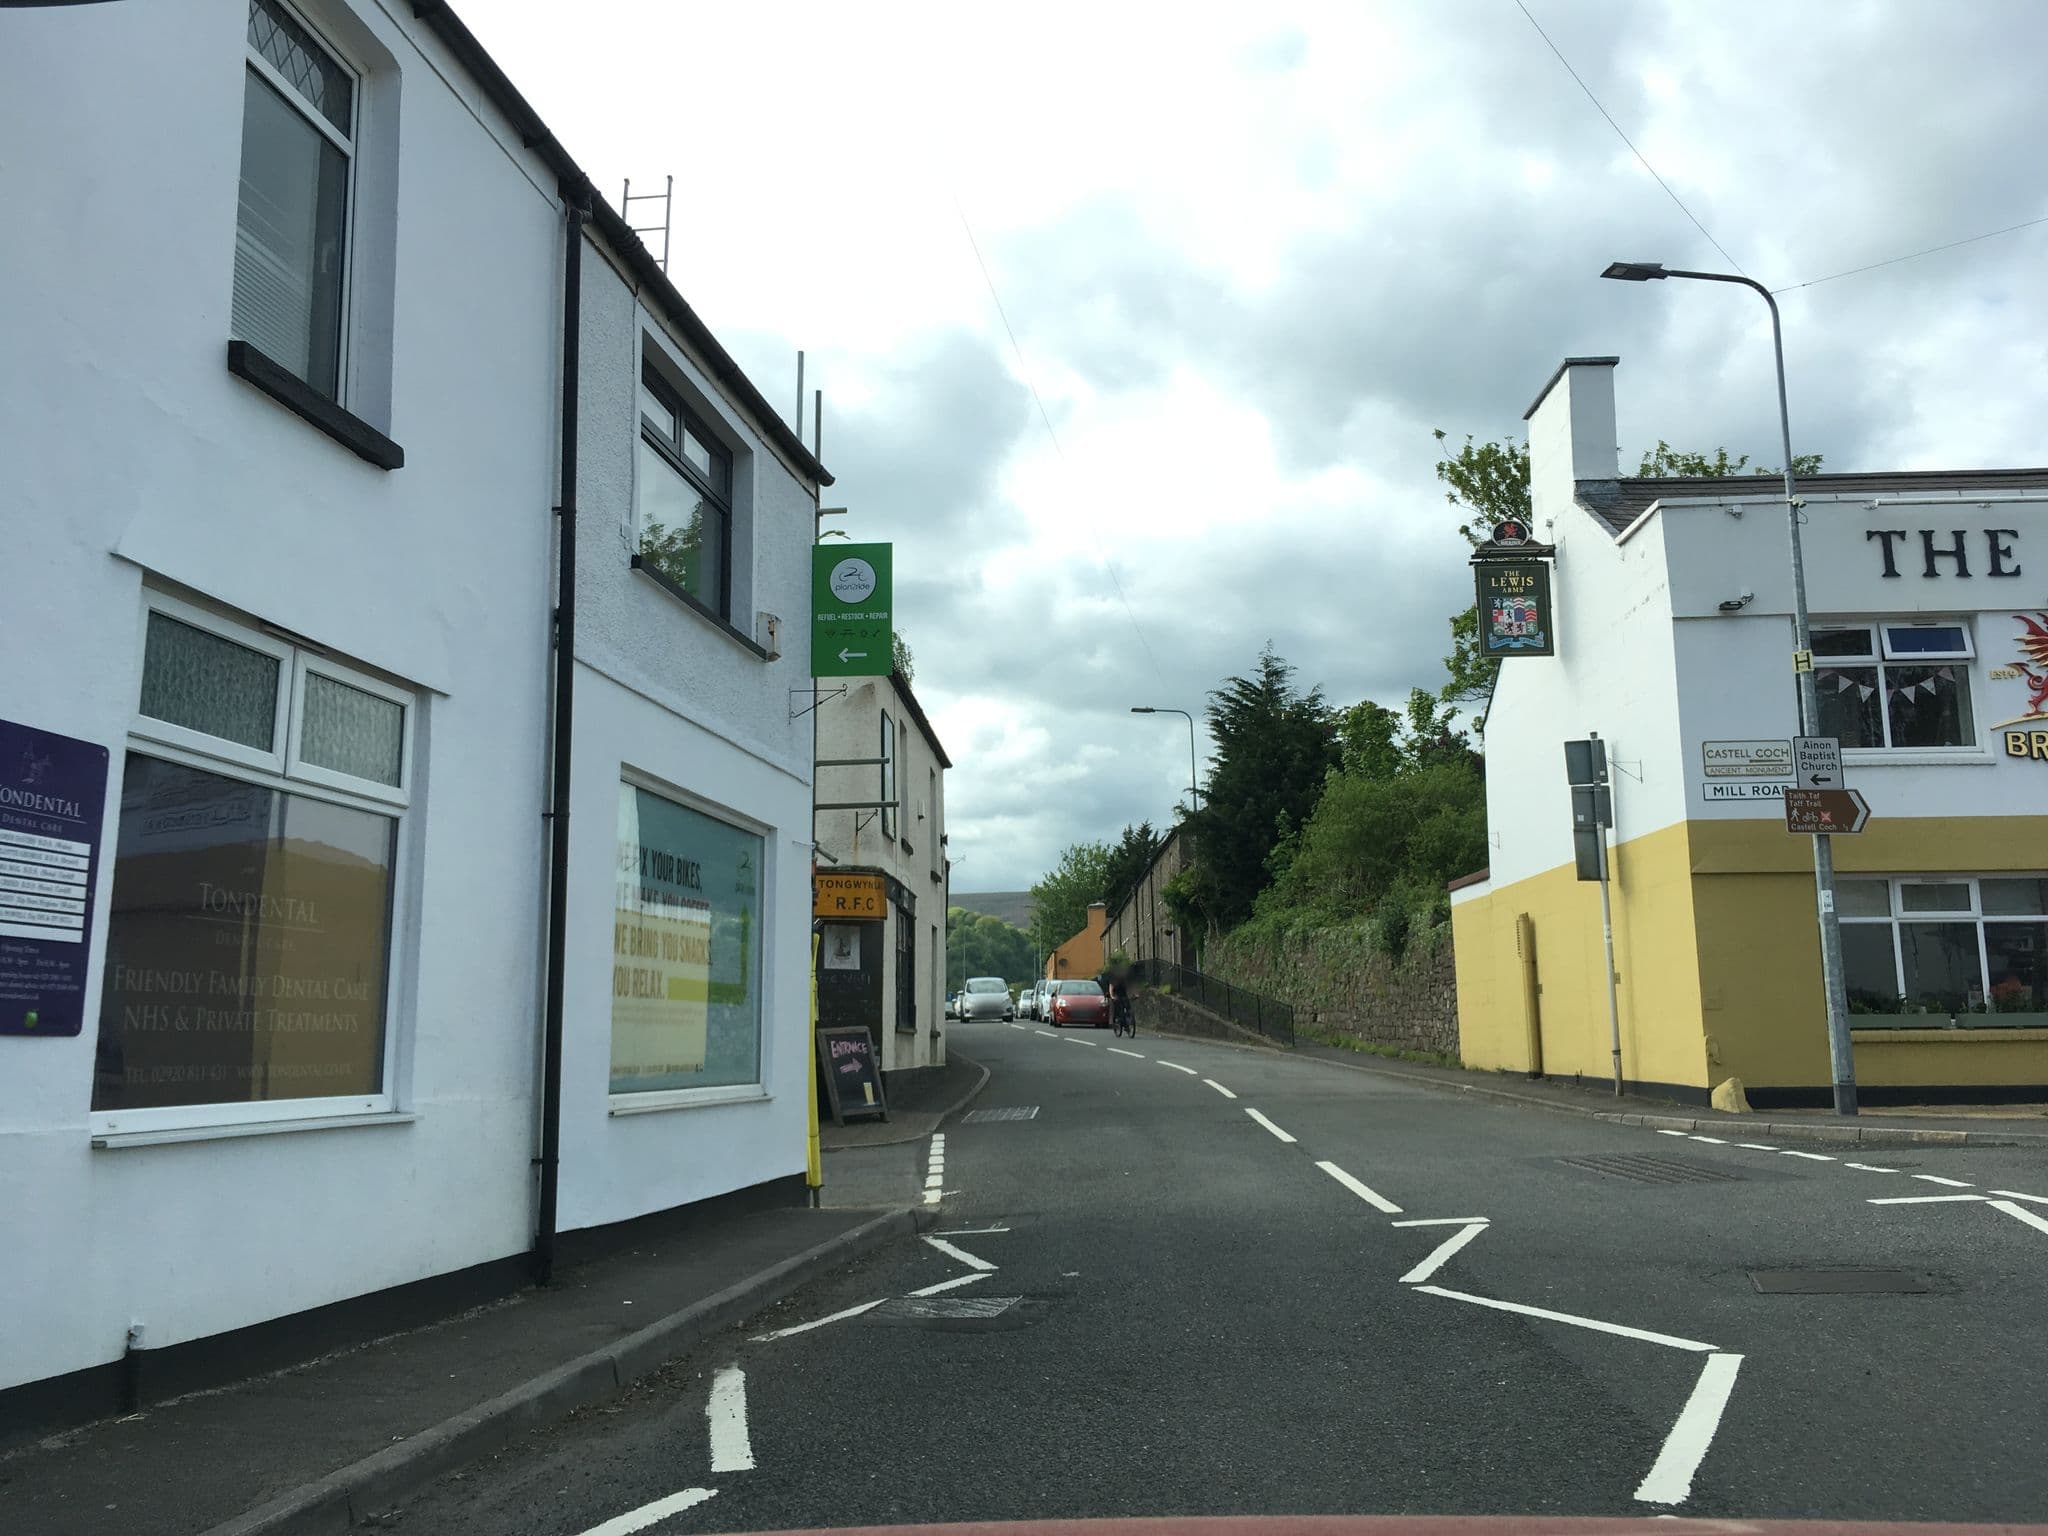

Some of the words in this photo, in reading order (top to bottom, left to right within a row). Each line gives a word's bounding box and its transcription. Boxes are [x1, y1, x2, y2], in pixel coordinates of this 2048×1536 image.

[1866, 529, 2021, 578] THE
[1491, 576, 1534, 587] LEWIS
[869, 611, 888, 620] REPAIR
[1794, 652, 1811, 671] H
[1804, 741, 1831, 750] Ainon
[1706, 749, 1751, 759] CASTELL
[1755, 748, 1789, 758] COCH
[1800, 751, 1836, 761] Baptist
[1710, 767, 1741, 775] ANCIENT
[1746, 766, 1787, 774] MONUMENT
[1801, 761, 1838, 771] Church
[1713, 785, 1746, 797] MILL
[1791, 823, 1817, 831] Castell
[1819, 823, 1837, 831] Coch
[652, 848, 674, 883] YOUR
[676, 856, 702, 894] BIKES,
[630, 925, 658, 958] BRING
[662, 930, 679, 961] YOU
[113, 964, 203, 993] FRIENDLY
[272, 975, 329, 1000] DENTAL
[334, 976, 369, 1001] CARE
[632, 967, 665, 1000] RELAX.
[123, 1005, 168, 1032] NHS
[175, 1007, 190, 1032] &
[195, 1007, 261, 1032] PRIVATE
[267, 1008, 360, 1032] TREATMENTS
